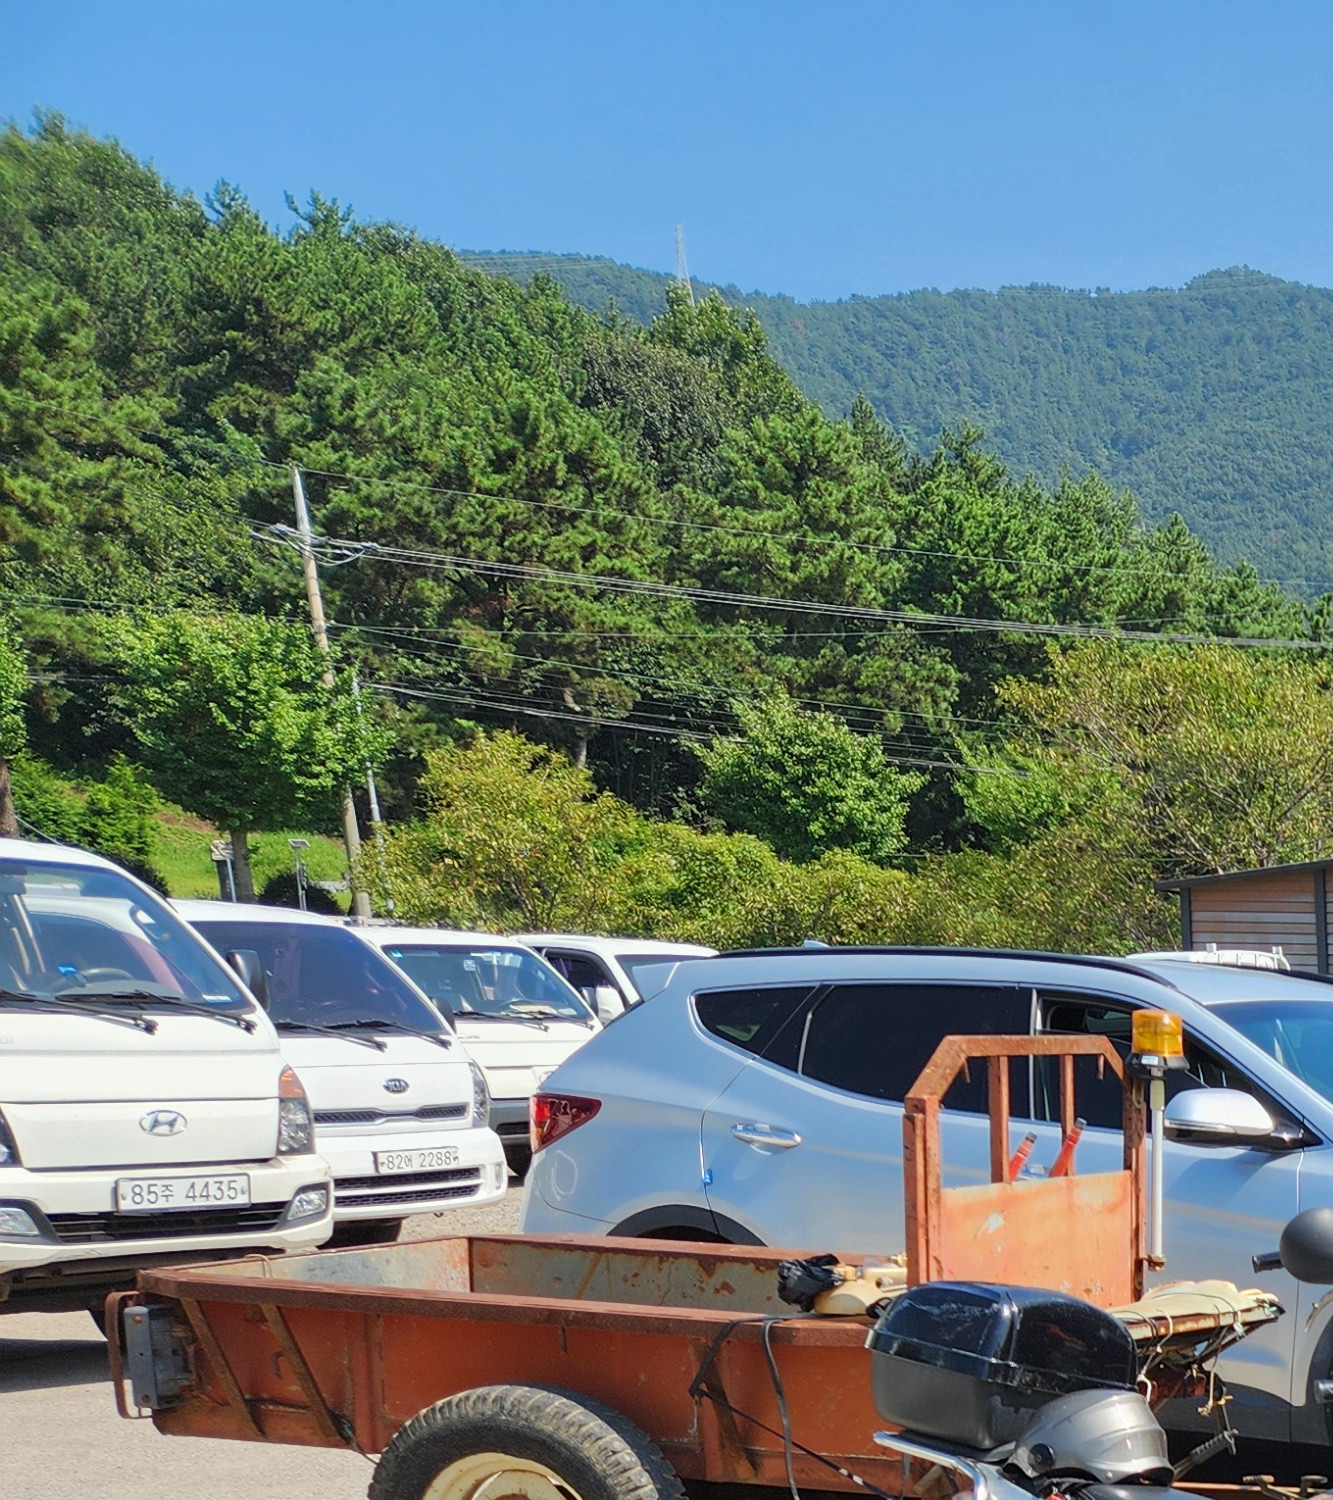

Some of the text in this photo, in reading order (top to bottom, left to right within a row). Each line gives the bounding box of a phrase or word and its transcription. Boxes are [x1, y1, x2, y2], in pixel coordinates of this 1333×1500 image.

[419, 1151, 452, 1168] 2288
[131, 1180, 238, 1205] 85주 4435
